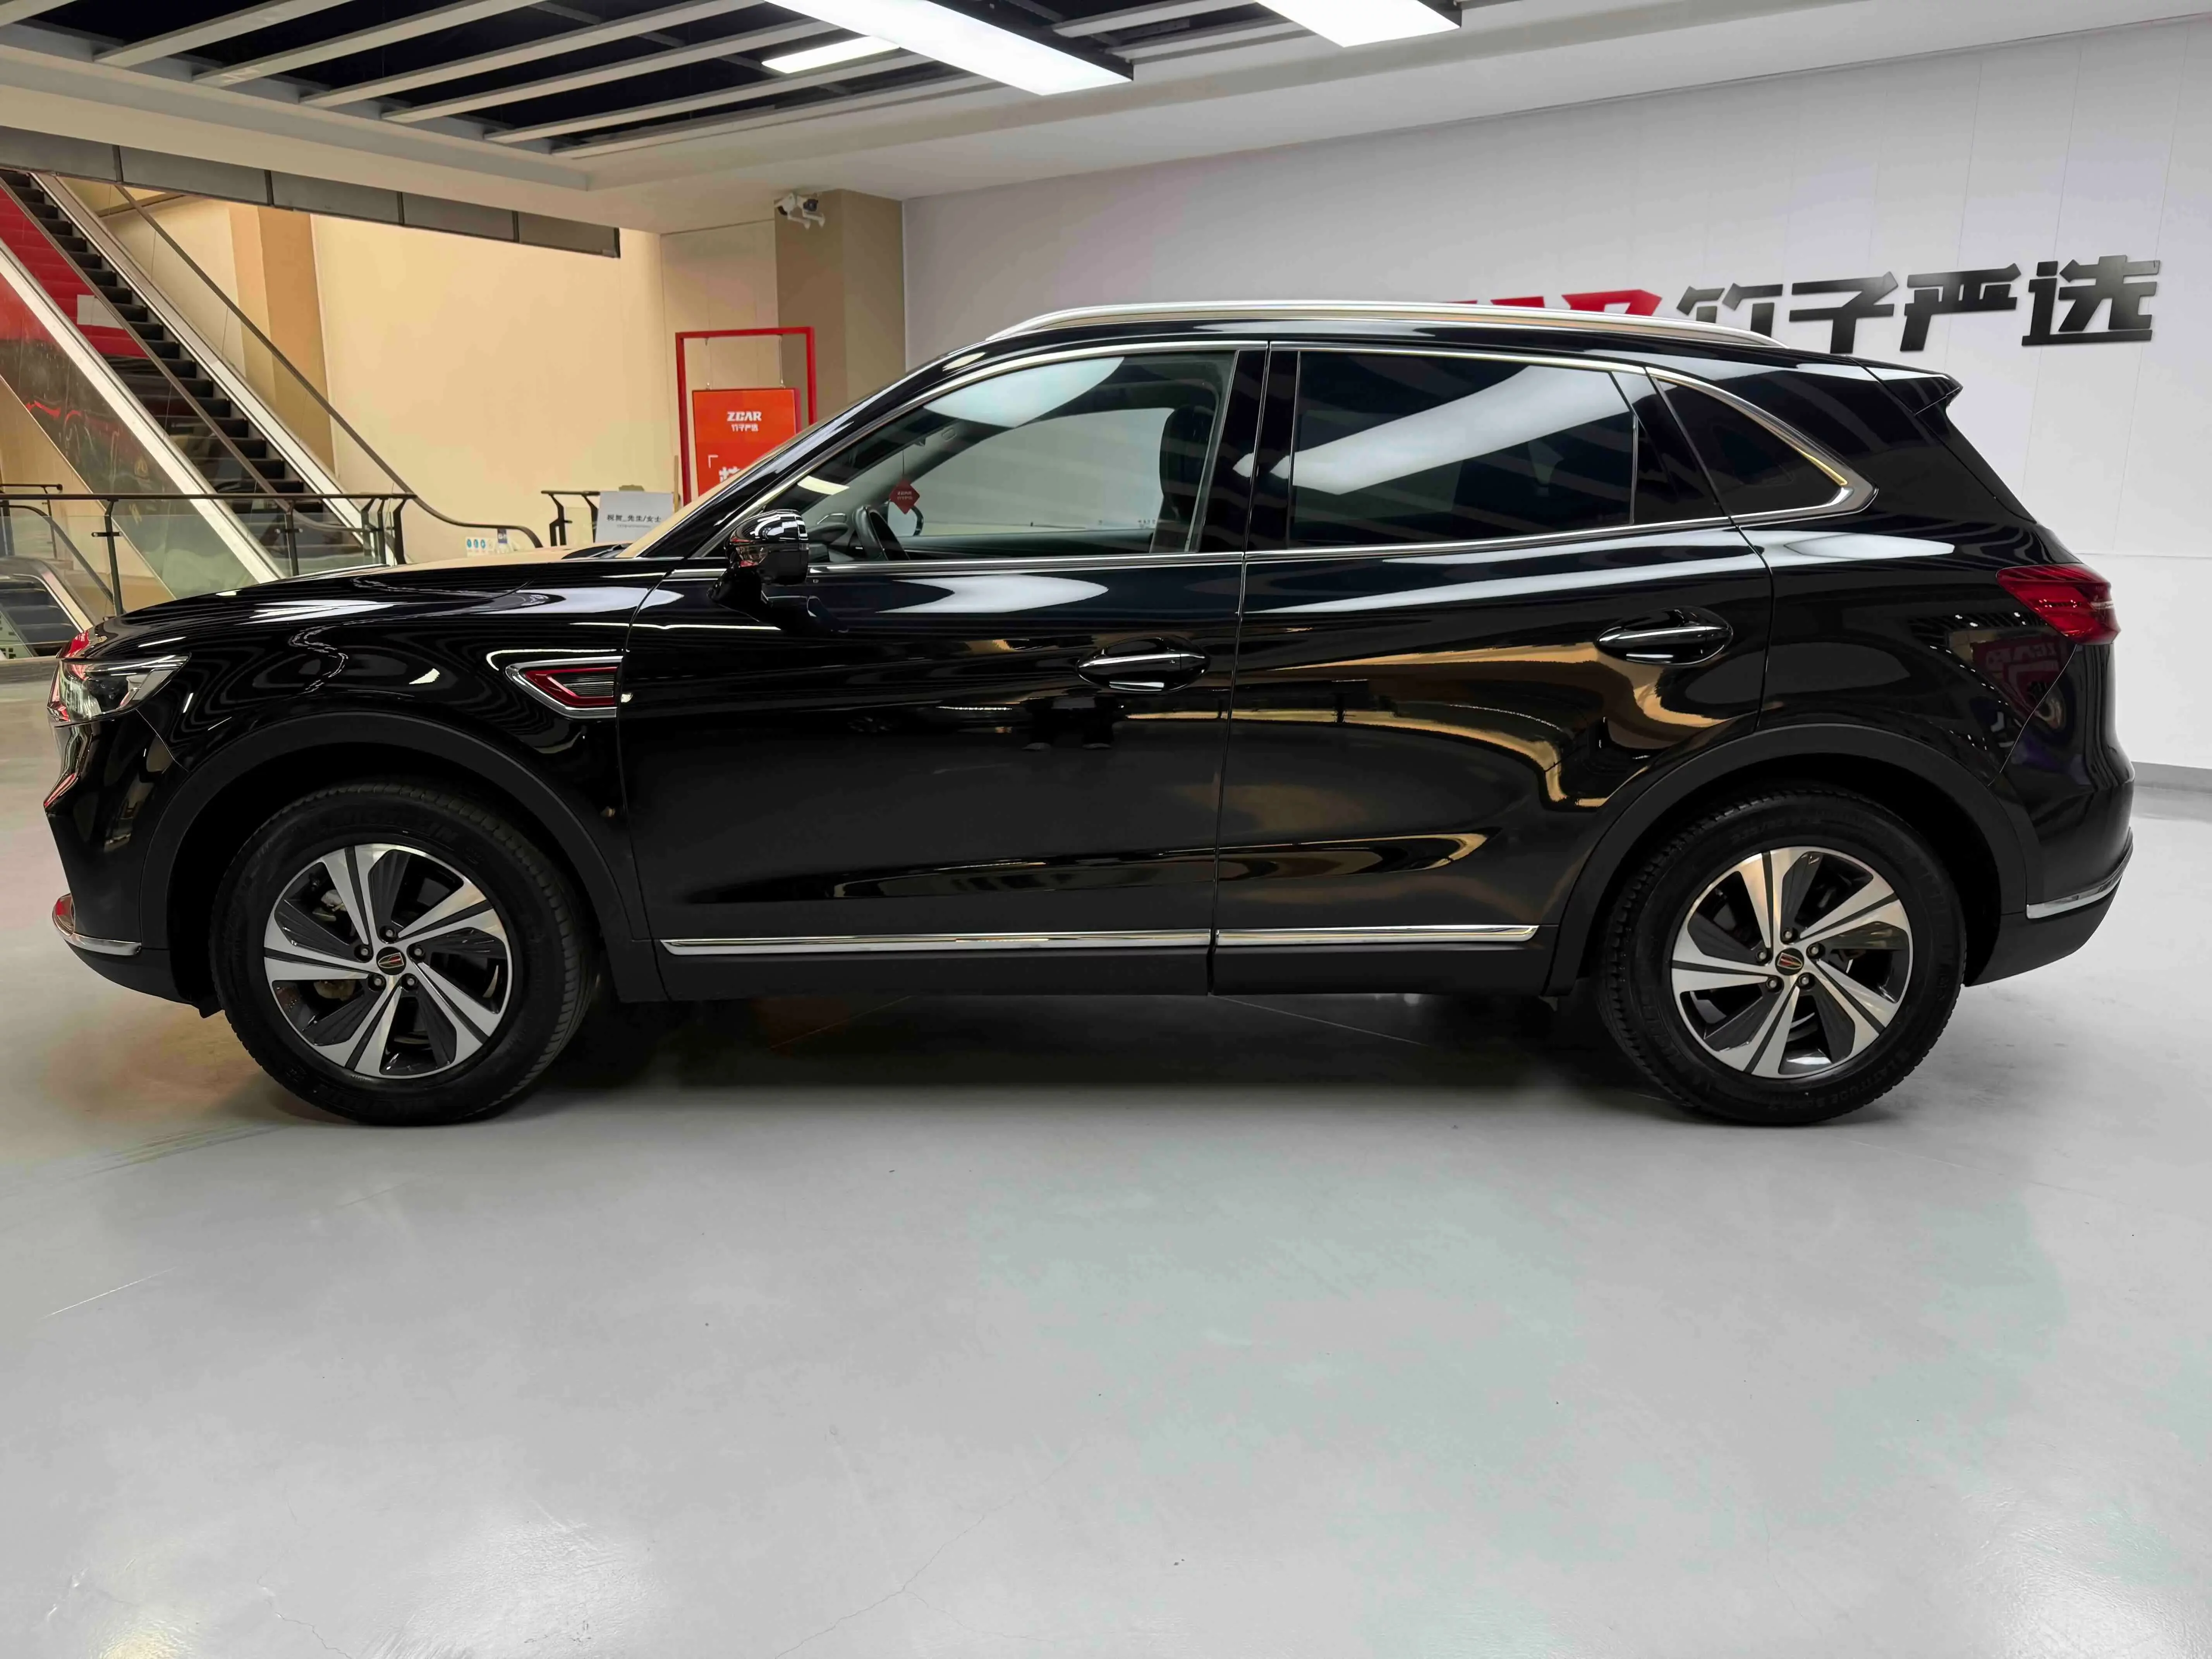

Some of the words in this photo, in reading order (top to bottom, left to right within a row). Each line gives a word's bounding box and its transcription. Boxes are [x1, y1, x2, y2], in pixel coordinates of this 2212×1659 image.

[1676, 254, 2160, 354] 竹子严选
[726, 411, 762, 422] ZCAR
